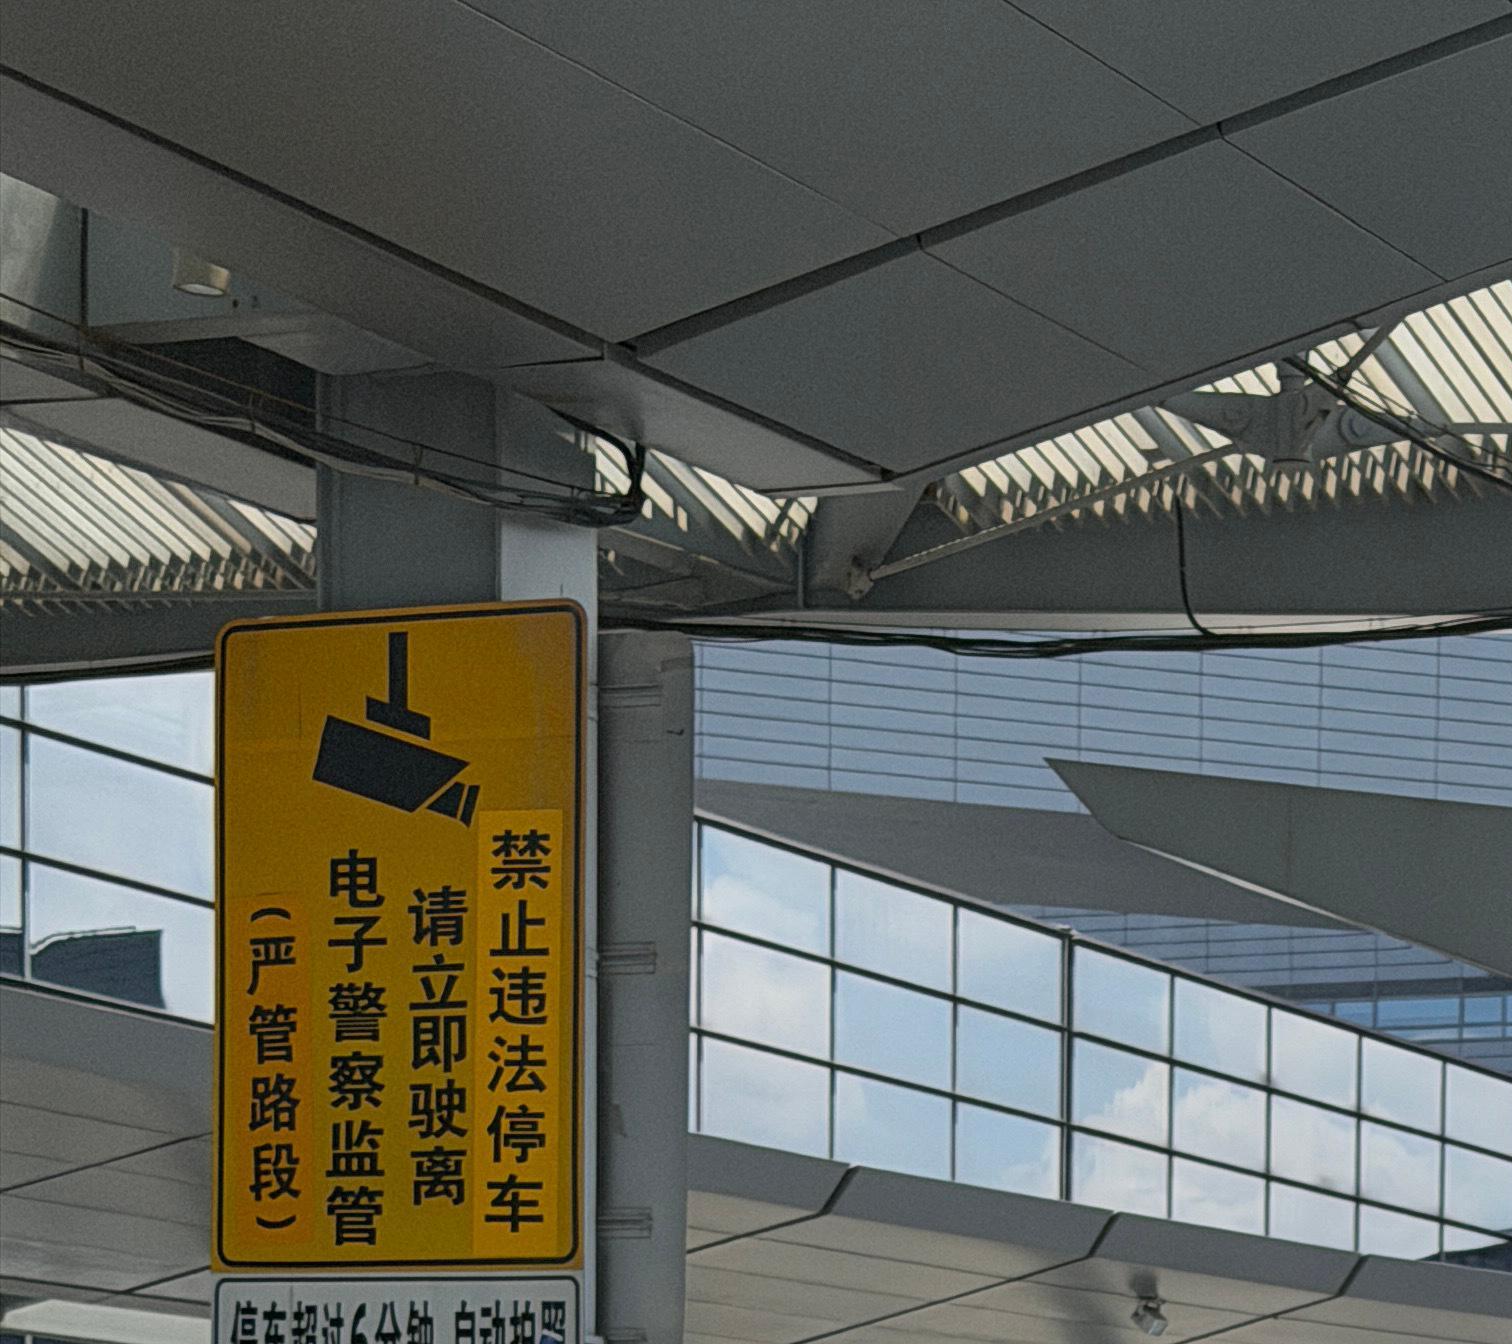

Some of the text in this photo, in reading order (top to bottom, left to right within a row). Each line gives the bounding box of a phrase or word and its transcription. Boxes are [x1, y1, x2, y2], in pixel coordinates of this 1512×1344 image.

[325, 849, 388, 1246] 电子警察监管
[408, 886, 468, 1205] 请立即驶离
[484, 829, 552, 1233] 禁止违法停车
